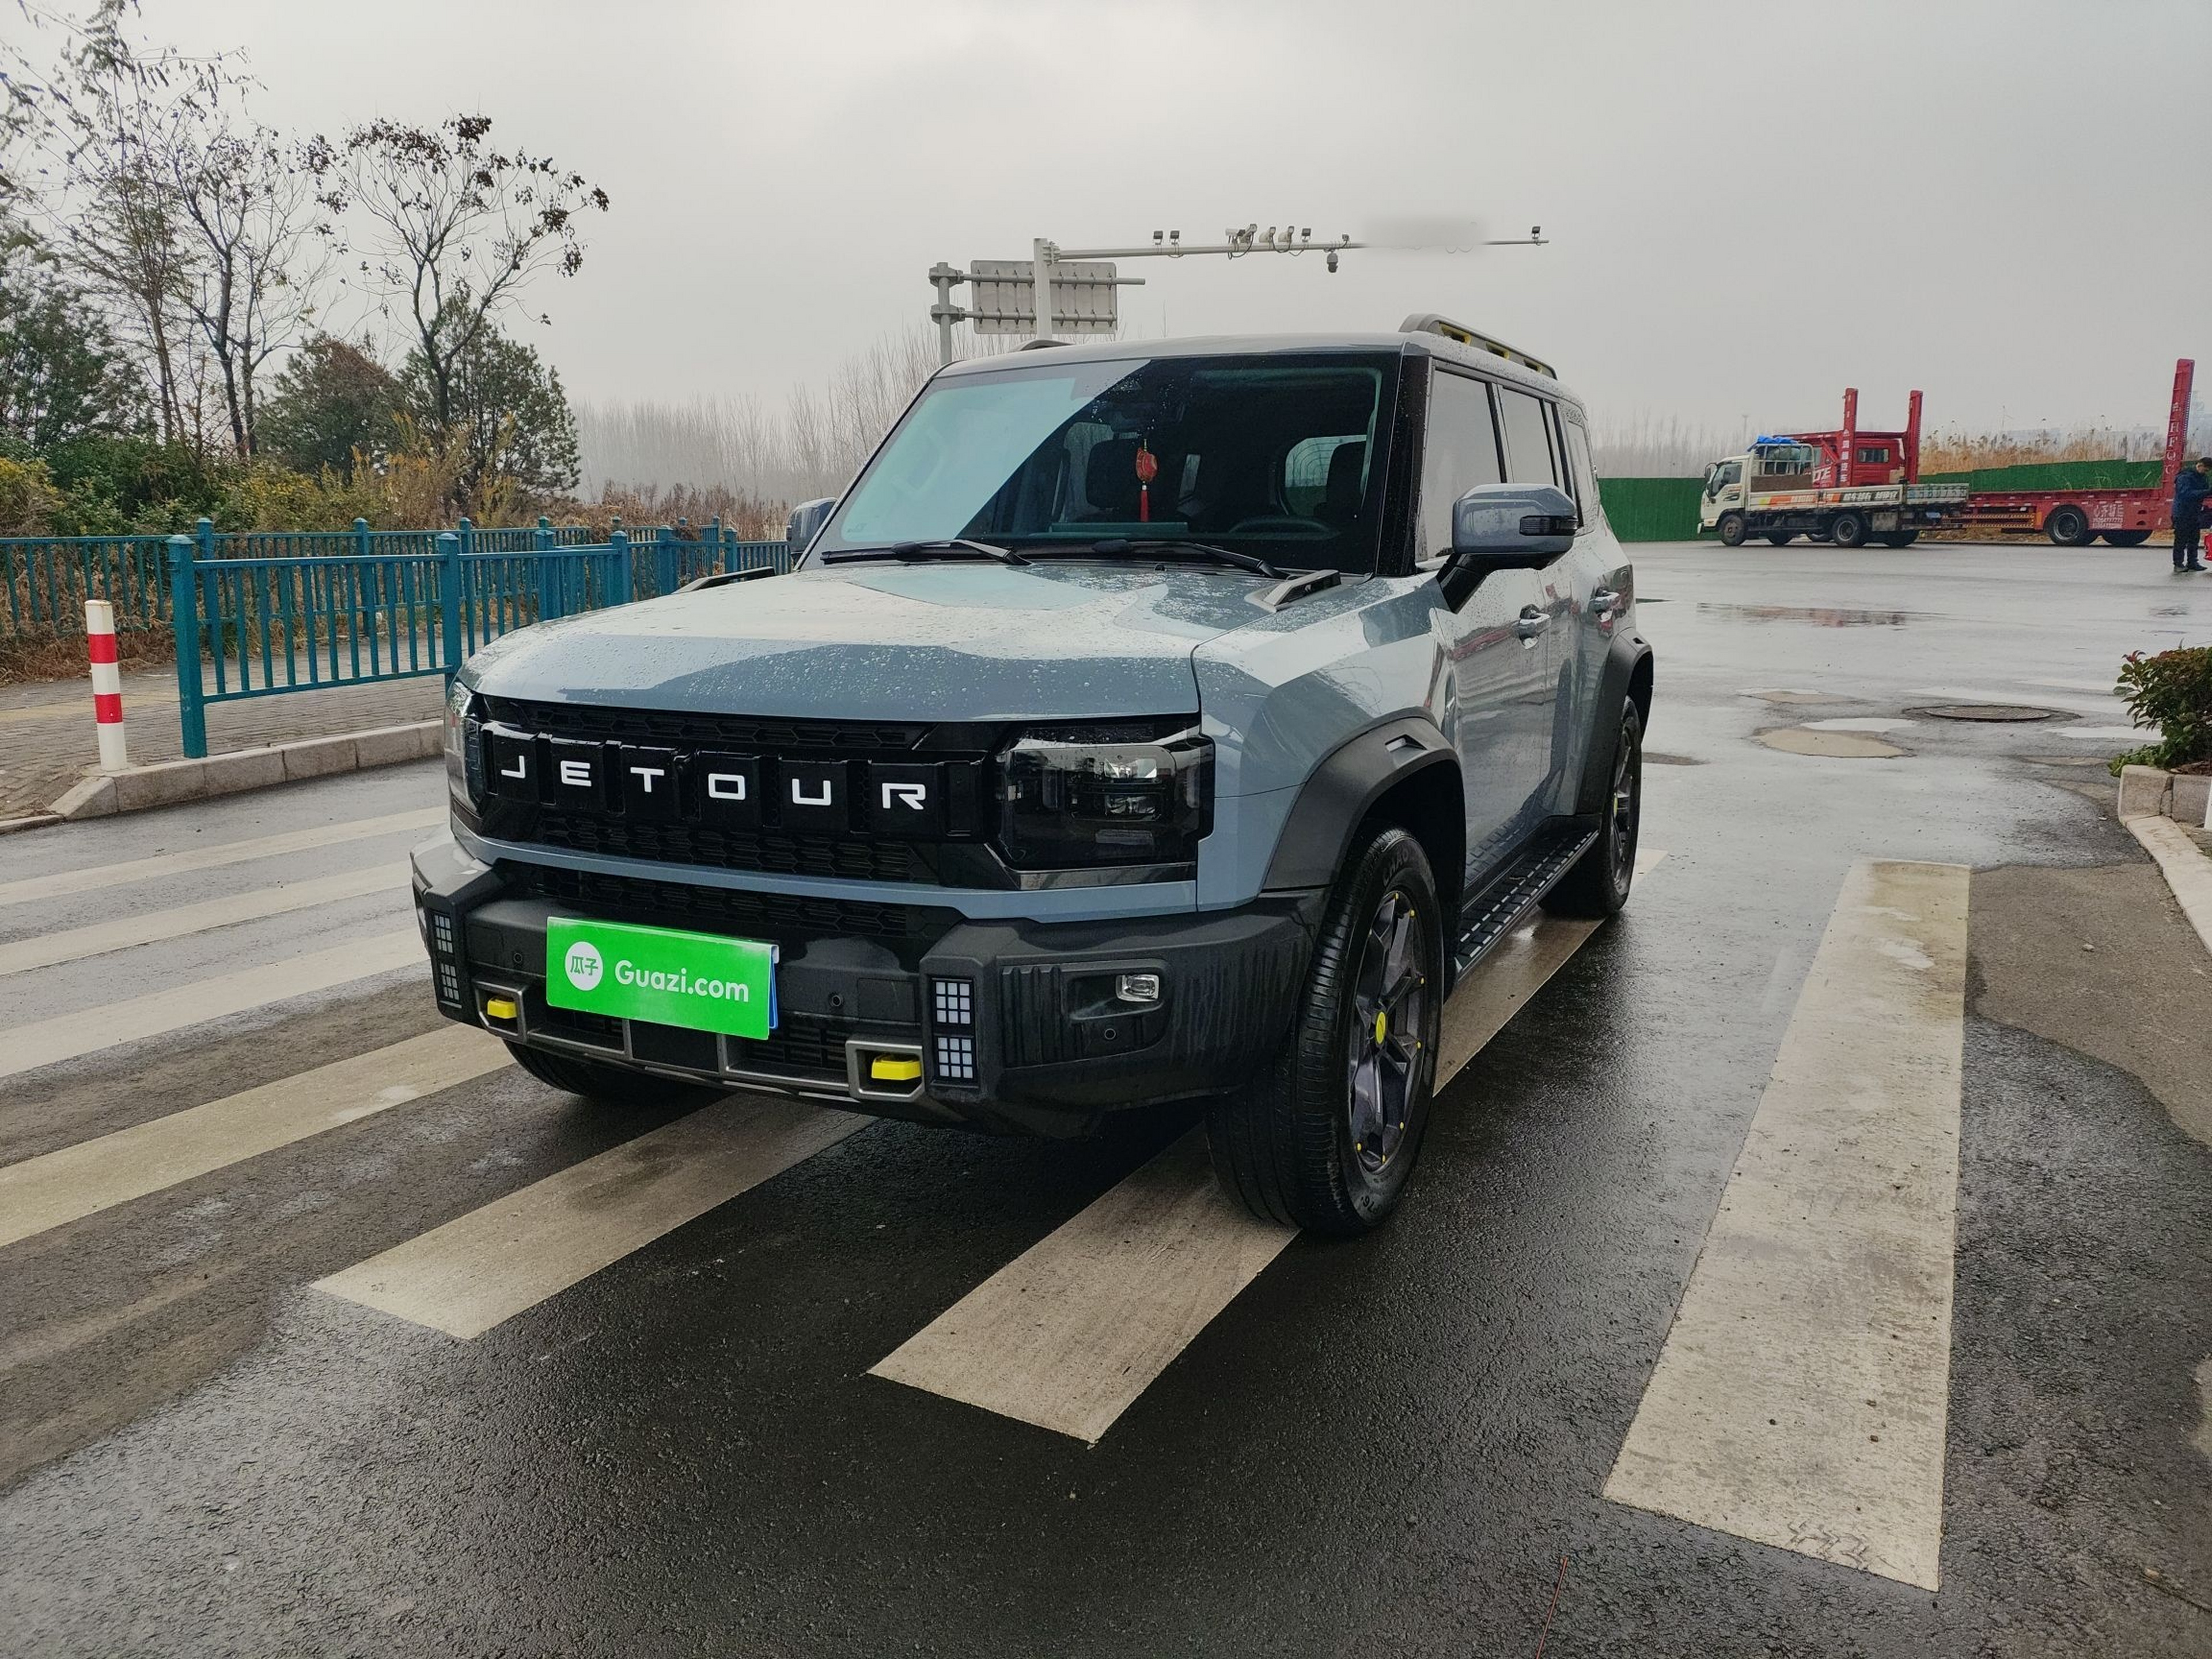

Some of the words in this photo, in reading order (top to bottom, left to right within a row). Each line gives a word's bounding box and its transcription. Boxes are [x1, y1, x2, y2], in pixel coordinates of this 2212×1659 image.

[501, 755, 926, 810] JETOUR
[570, 955, 599, 976] 瓜子
[615, 960, 749, 1002] Guazi.com
